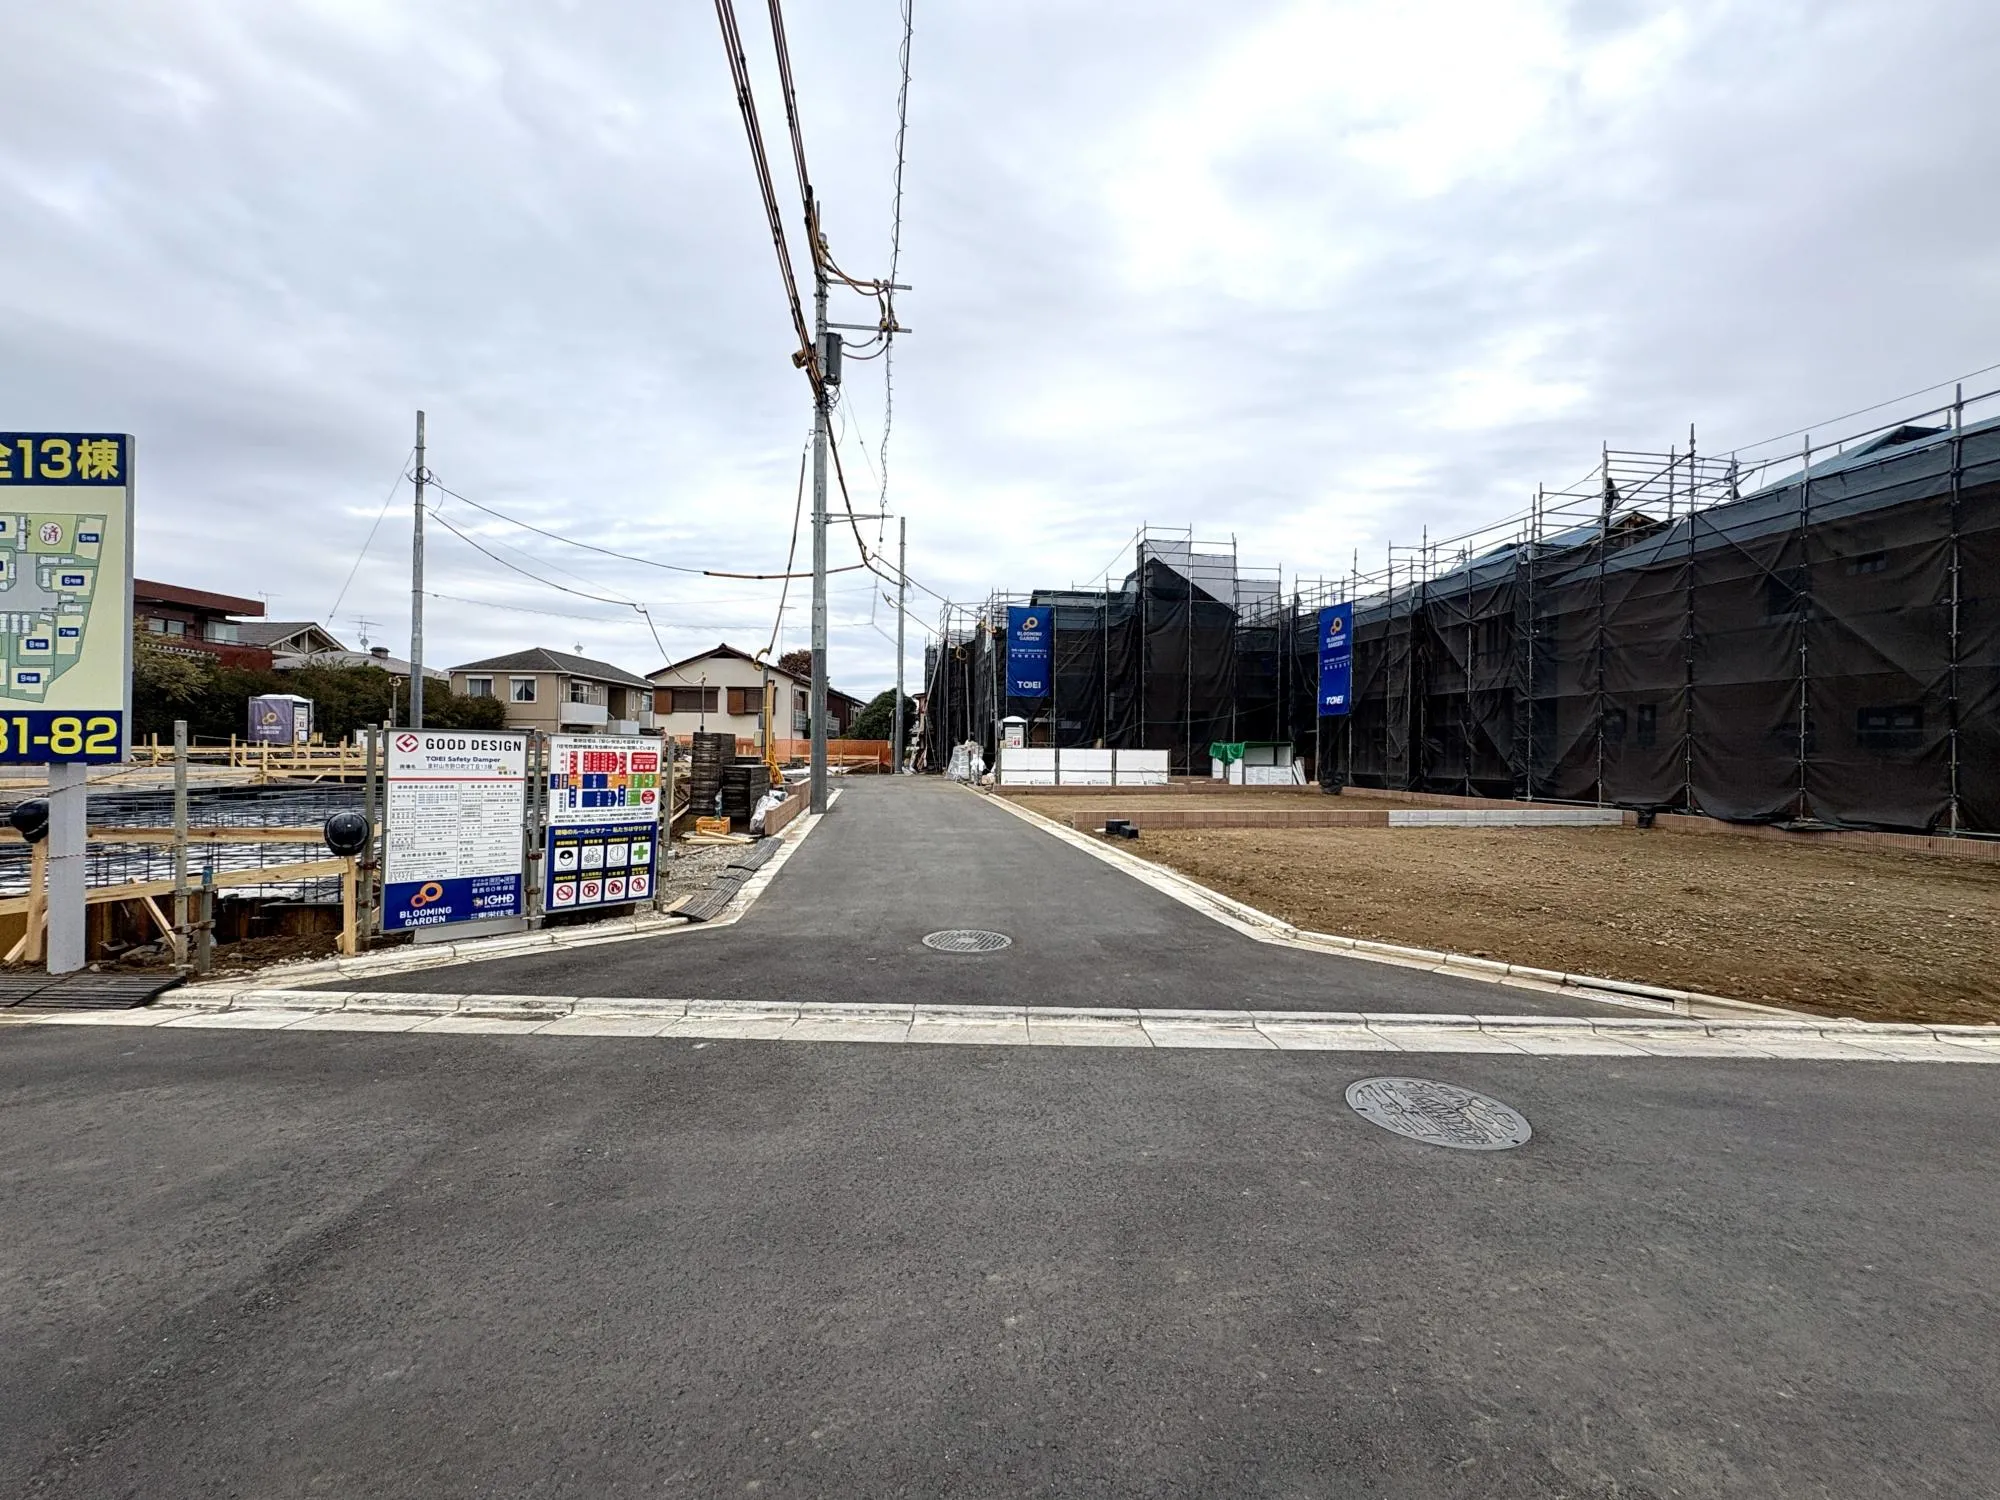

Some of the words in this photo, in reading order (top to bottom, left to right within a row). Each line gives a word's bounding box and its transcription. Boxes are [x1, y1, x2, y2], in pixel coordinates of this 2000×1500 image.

[426, 738, 466, 750] GOOD
[471, 739, 522, 752] DESIGN
[447, 755, 471, 764] Safety
[473, 756, 501, 764] Damper
[399, 906, 452, 919] BLOOMING
[404, 915, 446, 927] GARDEN
